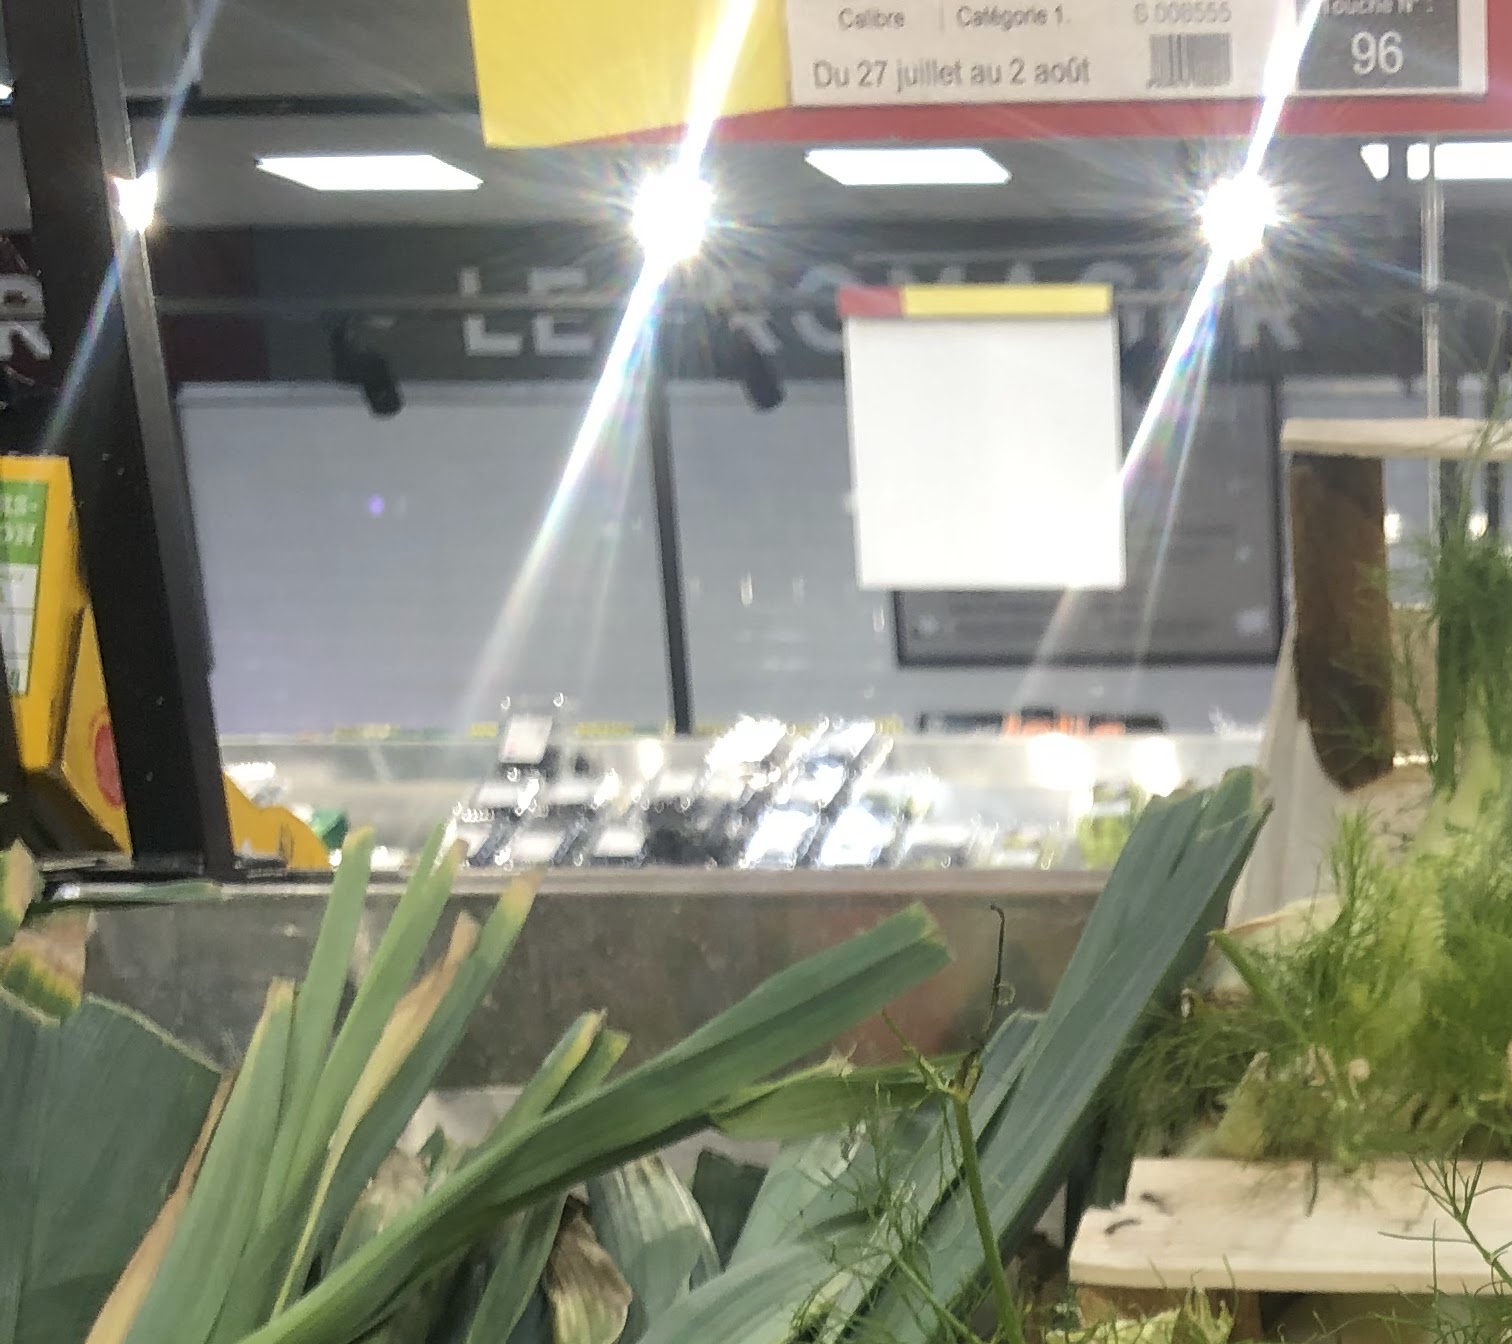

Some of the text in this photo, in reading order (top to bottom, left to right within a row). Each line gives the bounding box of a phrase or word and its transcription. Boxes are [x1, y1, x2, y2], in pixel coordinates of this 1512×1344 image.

[837, 7, 906, 29] Calibre
[955, 5, 1049, 31] Catégorie
[1351, 31, 1404, 76] 96
[812, 56, 1091, 93] Du 27 juillet au 2 août
[458, 266, 594, 357] LE
